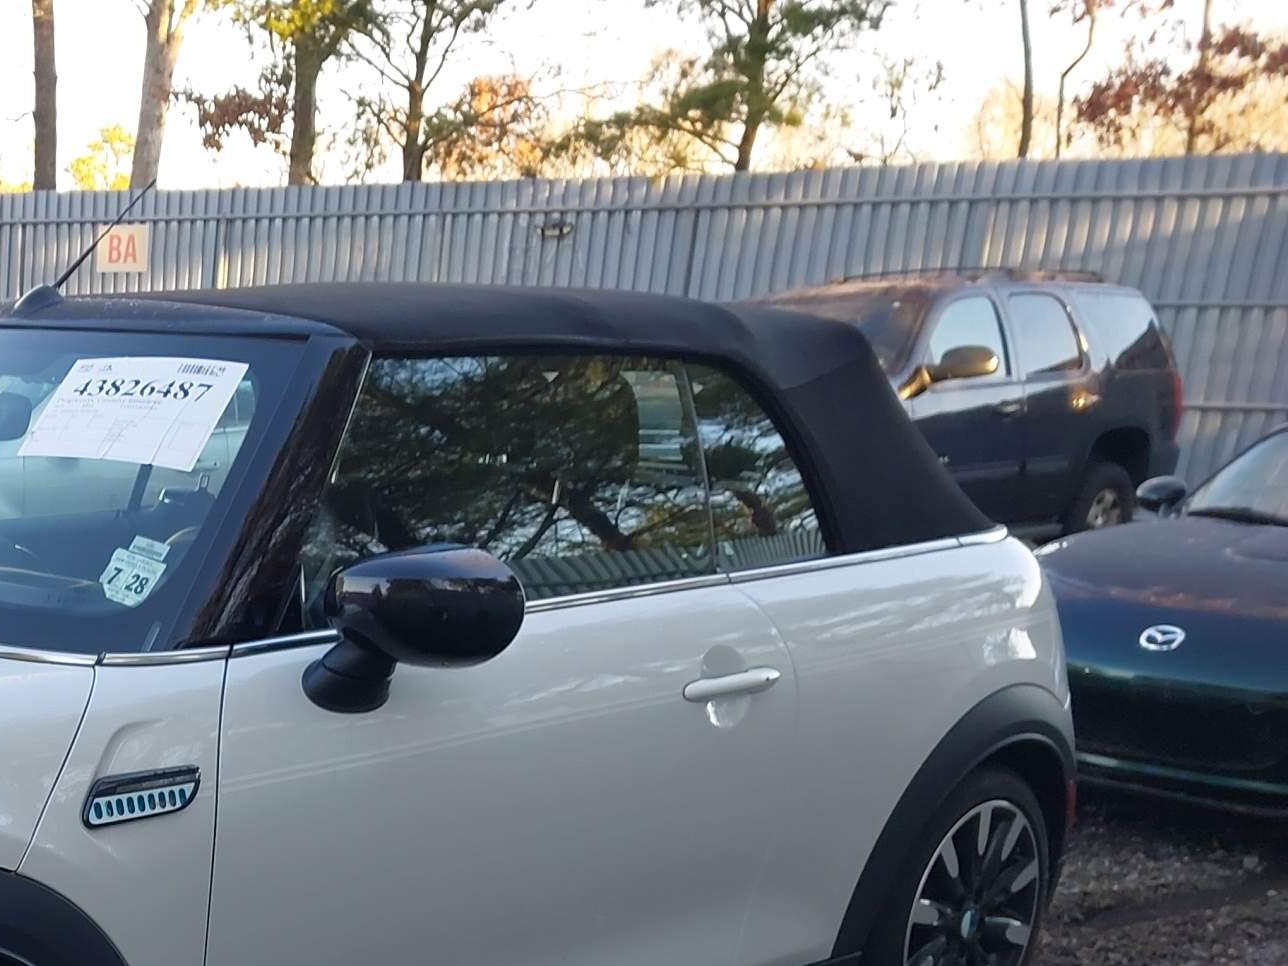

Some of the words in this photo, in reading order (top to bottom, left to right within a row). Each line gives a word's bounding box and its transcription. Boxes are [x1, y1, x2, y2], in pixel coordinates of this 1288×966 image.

[108, 233, 137, 264] BA
[73, 378, 214, 402] 43826487
[107, 566, 123, 585] 7
[124, 574, 149, 595] 28
